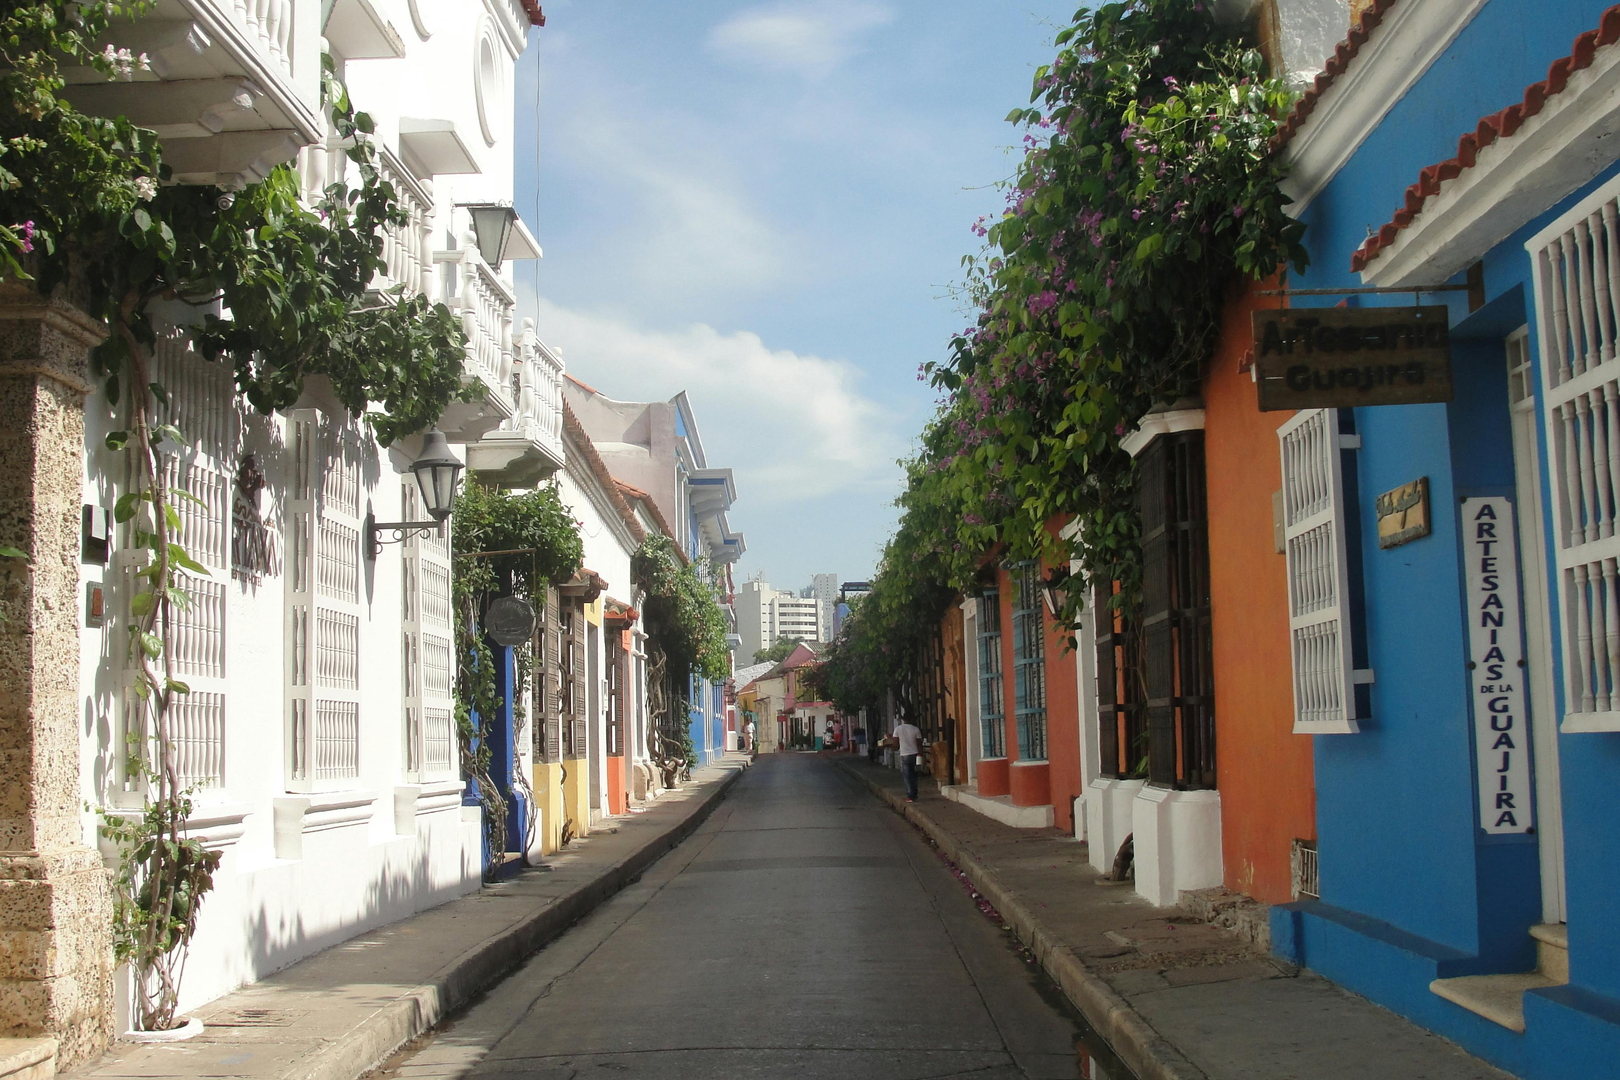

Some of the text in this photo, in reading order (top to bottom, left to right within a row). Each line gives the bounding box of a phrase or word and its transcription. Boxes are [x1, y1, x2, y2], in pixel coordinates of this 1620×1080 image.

[1285, 362, 1424, 392] Guajira
[1474, 504, 1505, 681] ARTESANIAS
[1480, 684, 1513, 693] DE LA
[1488, 696, 1517, 827] GUAJIRA
